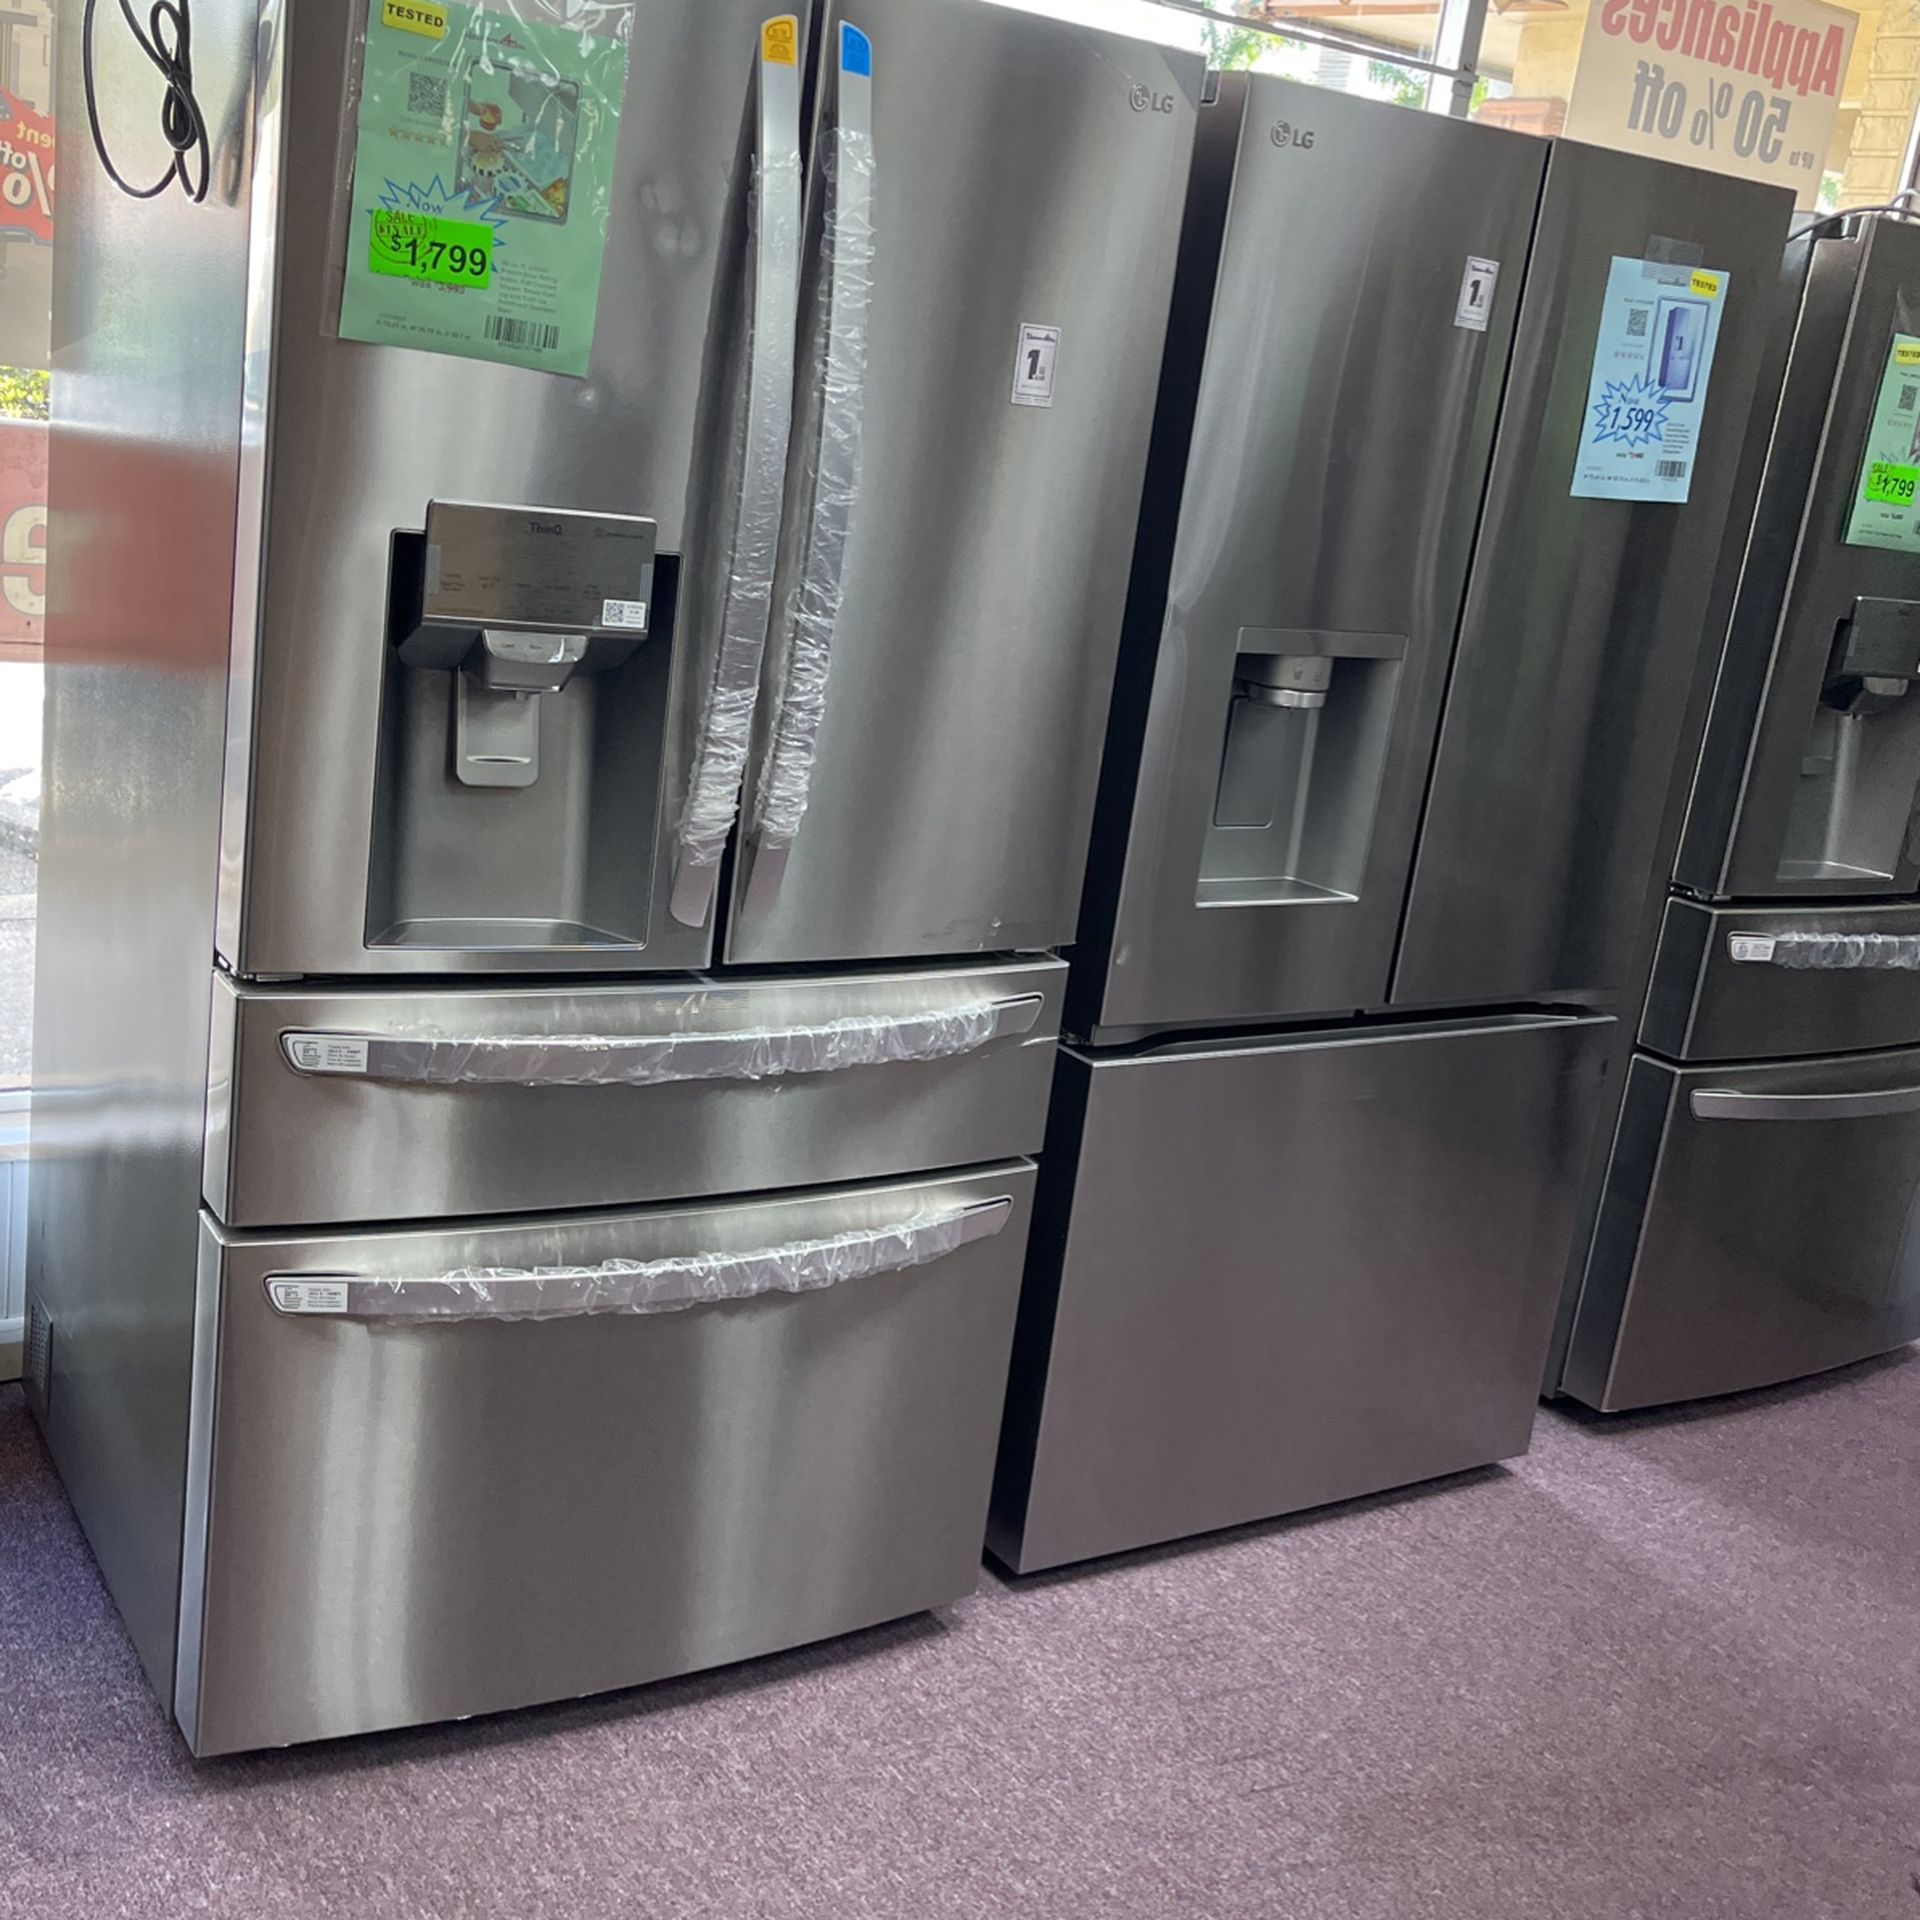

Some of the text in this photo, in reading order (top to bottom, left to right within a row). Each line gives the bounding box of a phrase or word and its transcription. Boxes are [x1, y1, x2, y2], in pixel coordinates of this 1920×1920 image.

[386, 2, 444, 28] TESTED
[405, 193, 443, 215] Now
[390, 231, 488, 276] $1,799
[1609, 405, 1655, 433] 1,599
[1875, 473, 1915, 498] $1,799
